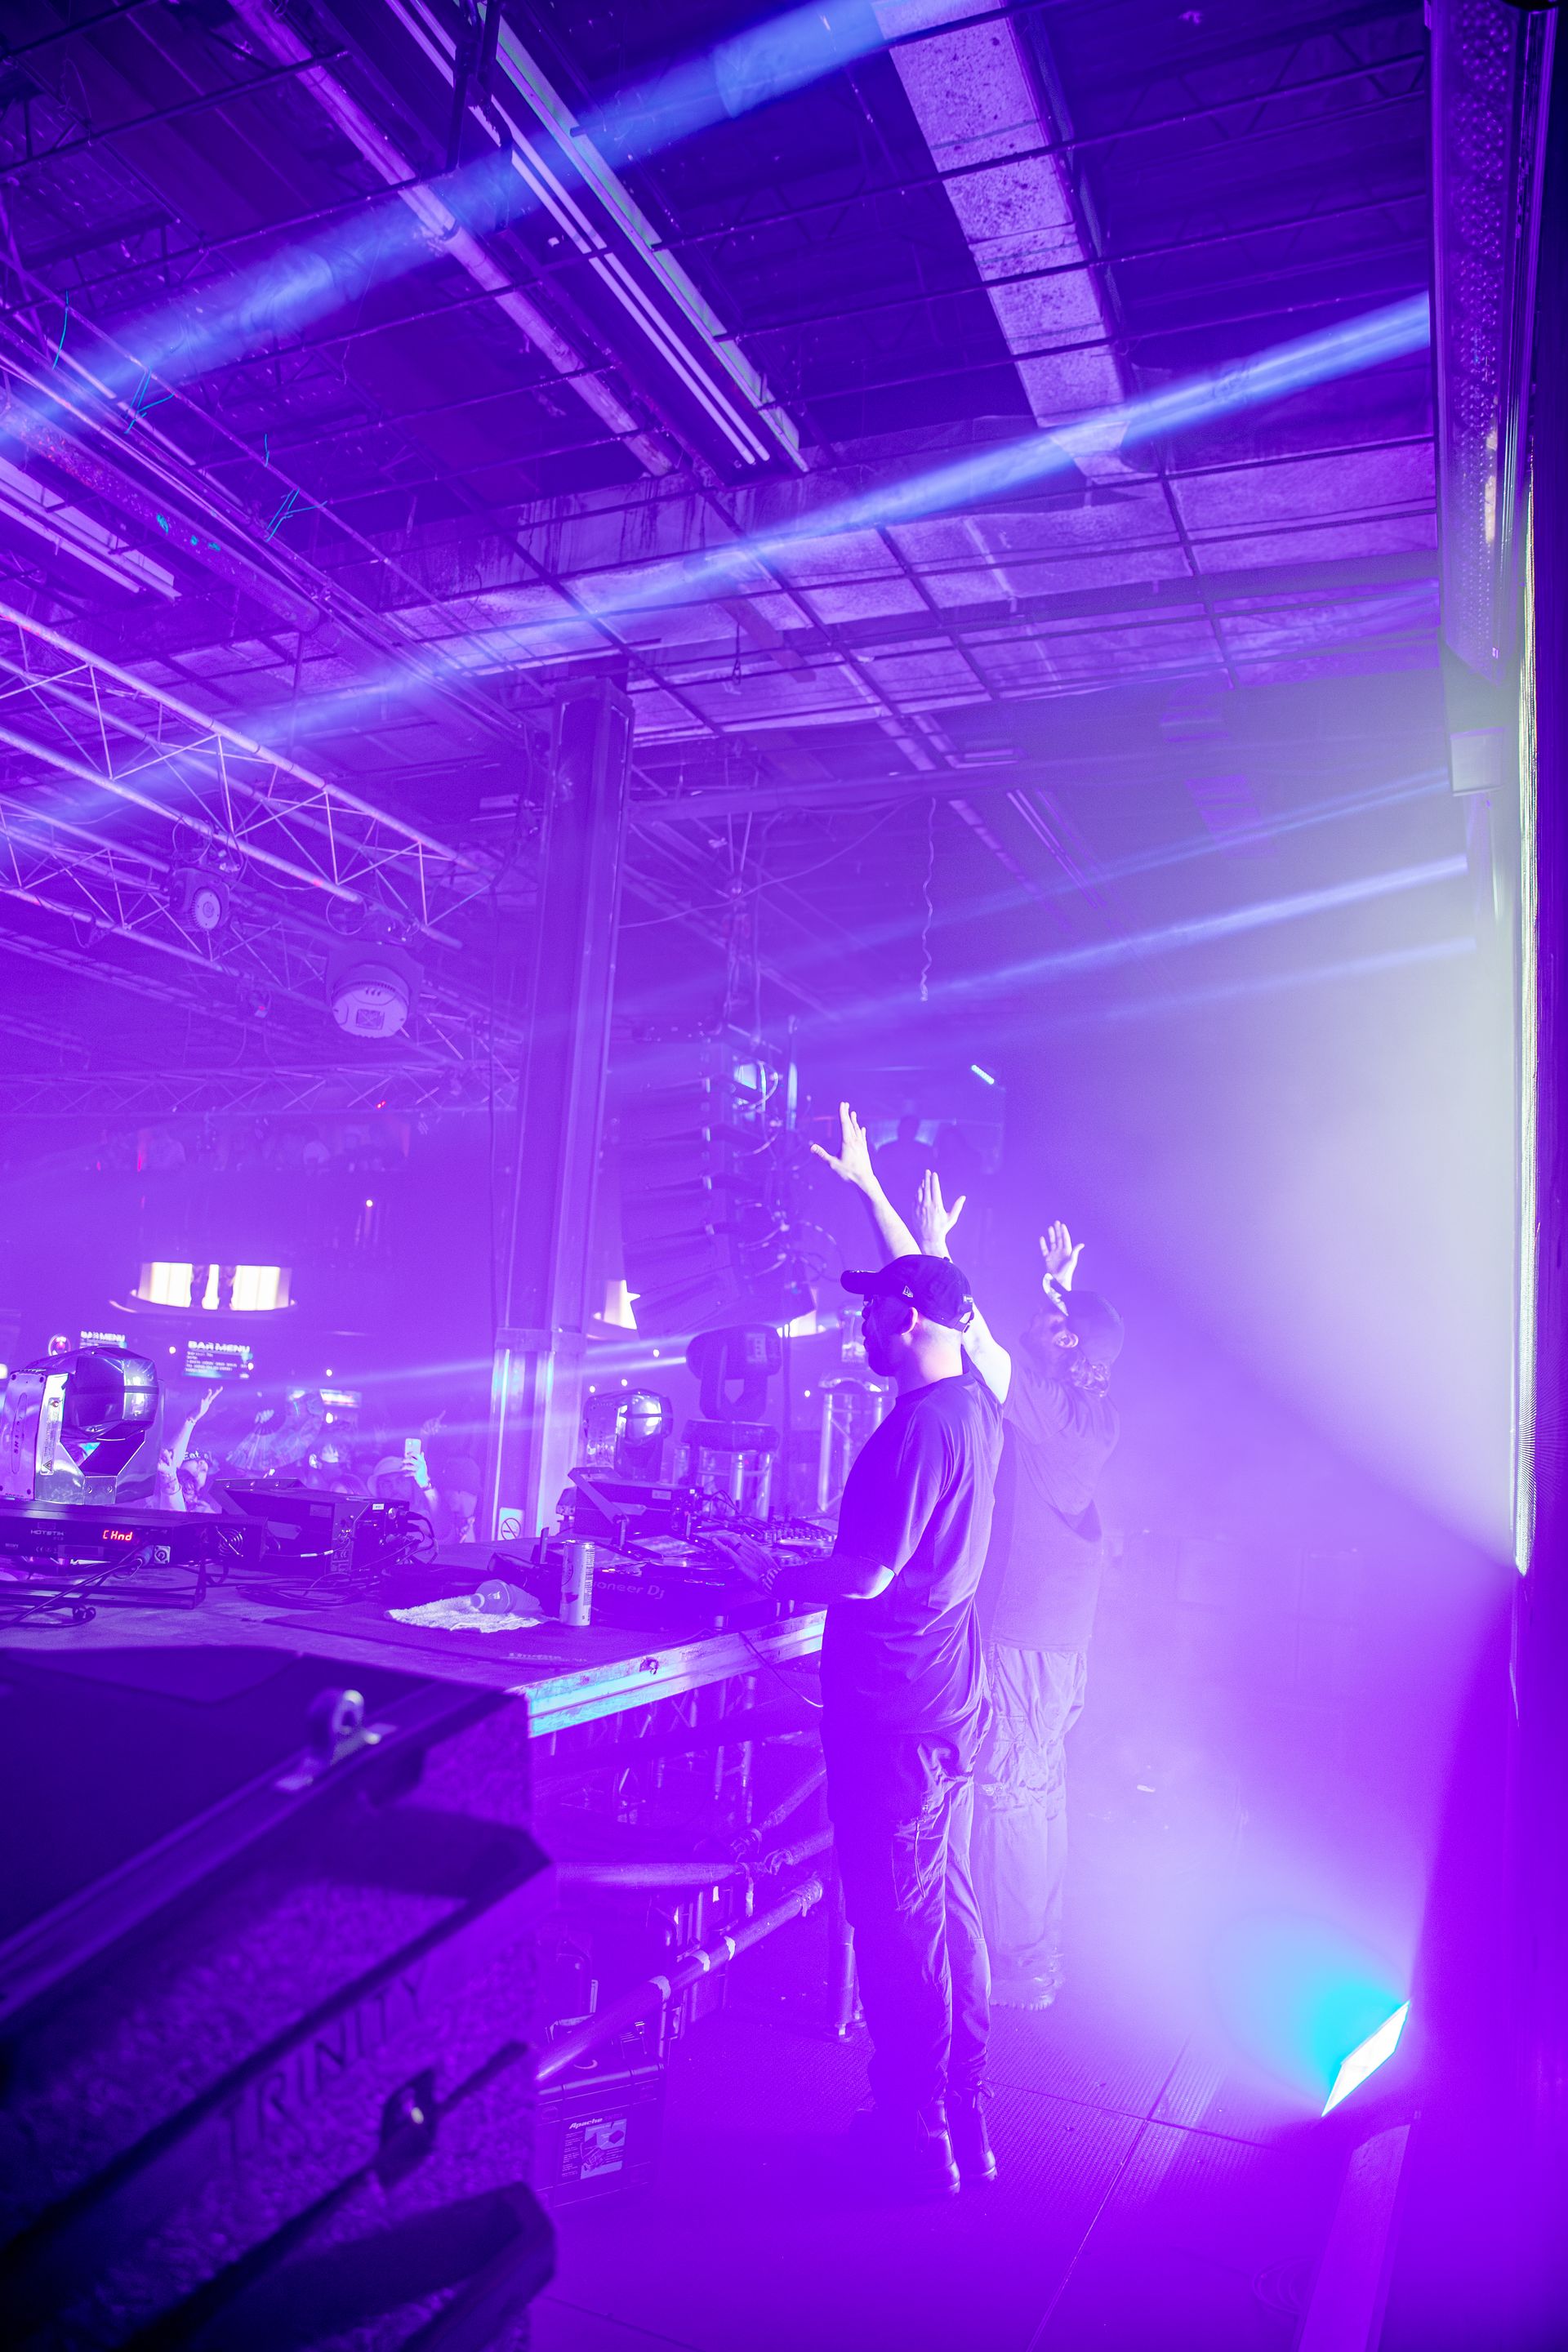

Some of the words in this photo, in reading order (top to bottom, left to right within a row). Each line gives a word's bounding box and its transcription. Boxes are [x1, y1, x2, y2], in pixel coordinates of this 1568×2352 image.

[100, 1333, 126, 1342] MENU
[188, 1340, 214, 1350] BAR
[215, 1343, 251, 1353] MENU
[218, 1962, 426, 2166] TRINITY
[568, 2118, 604, 2130] Apache
